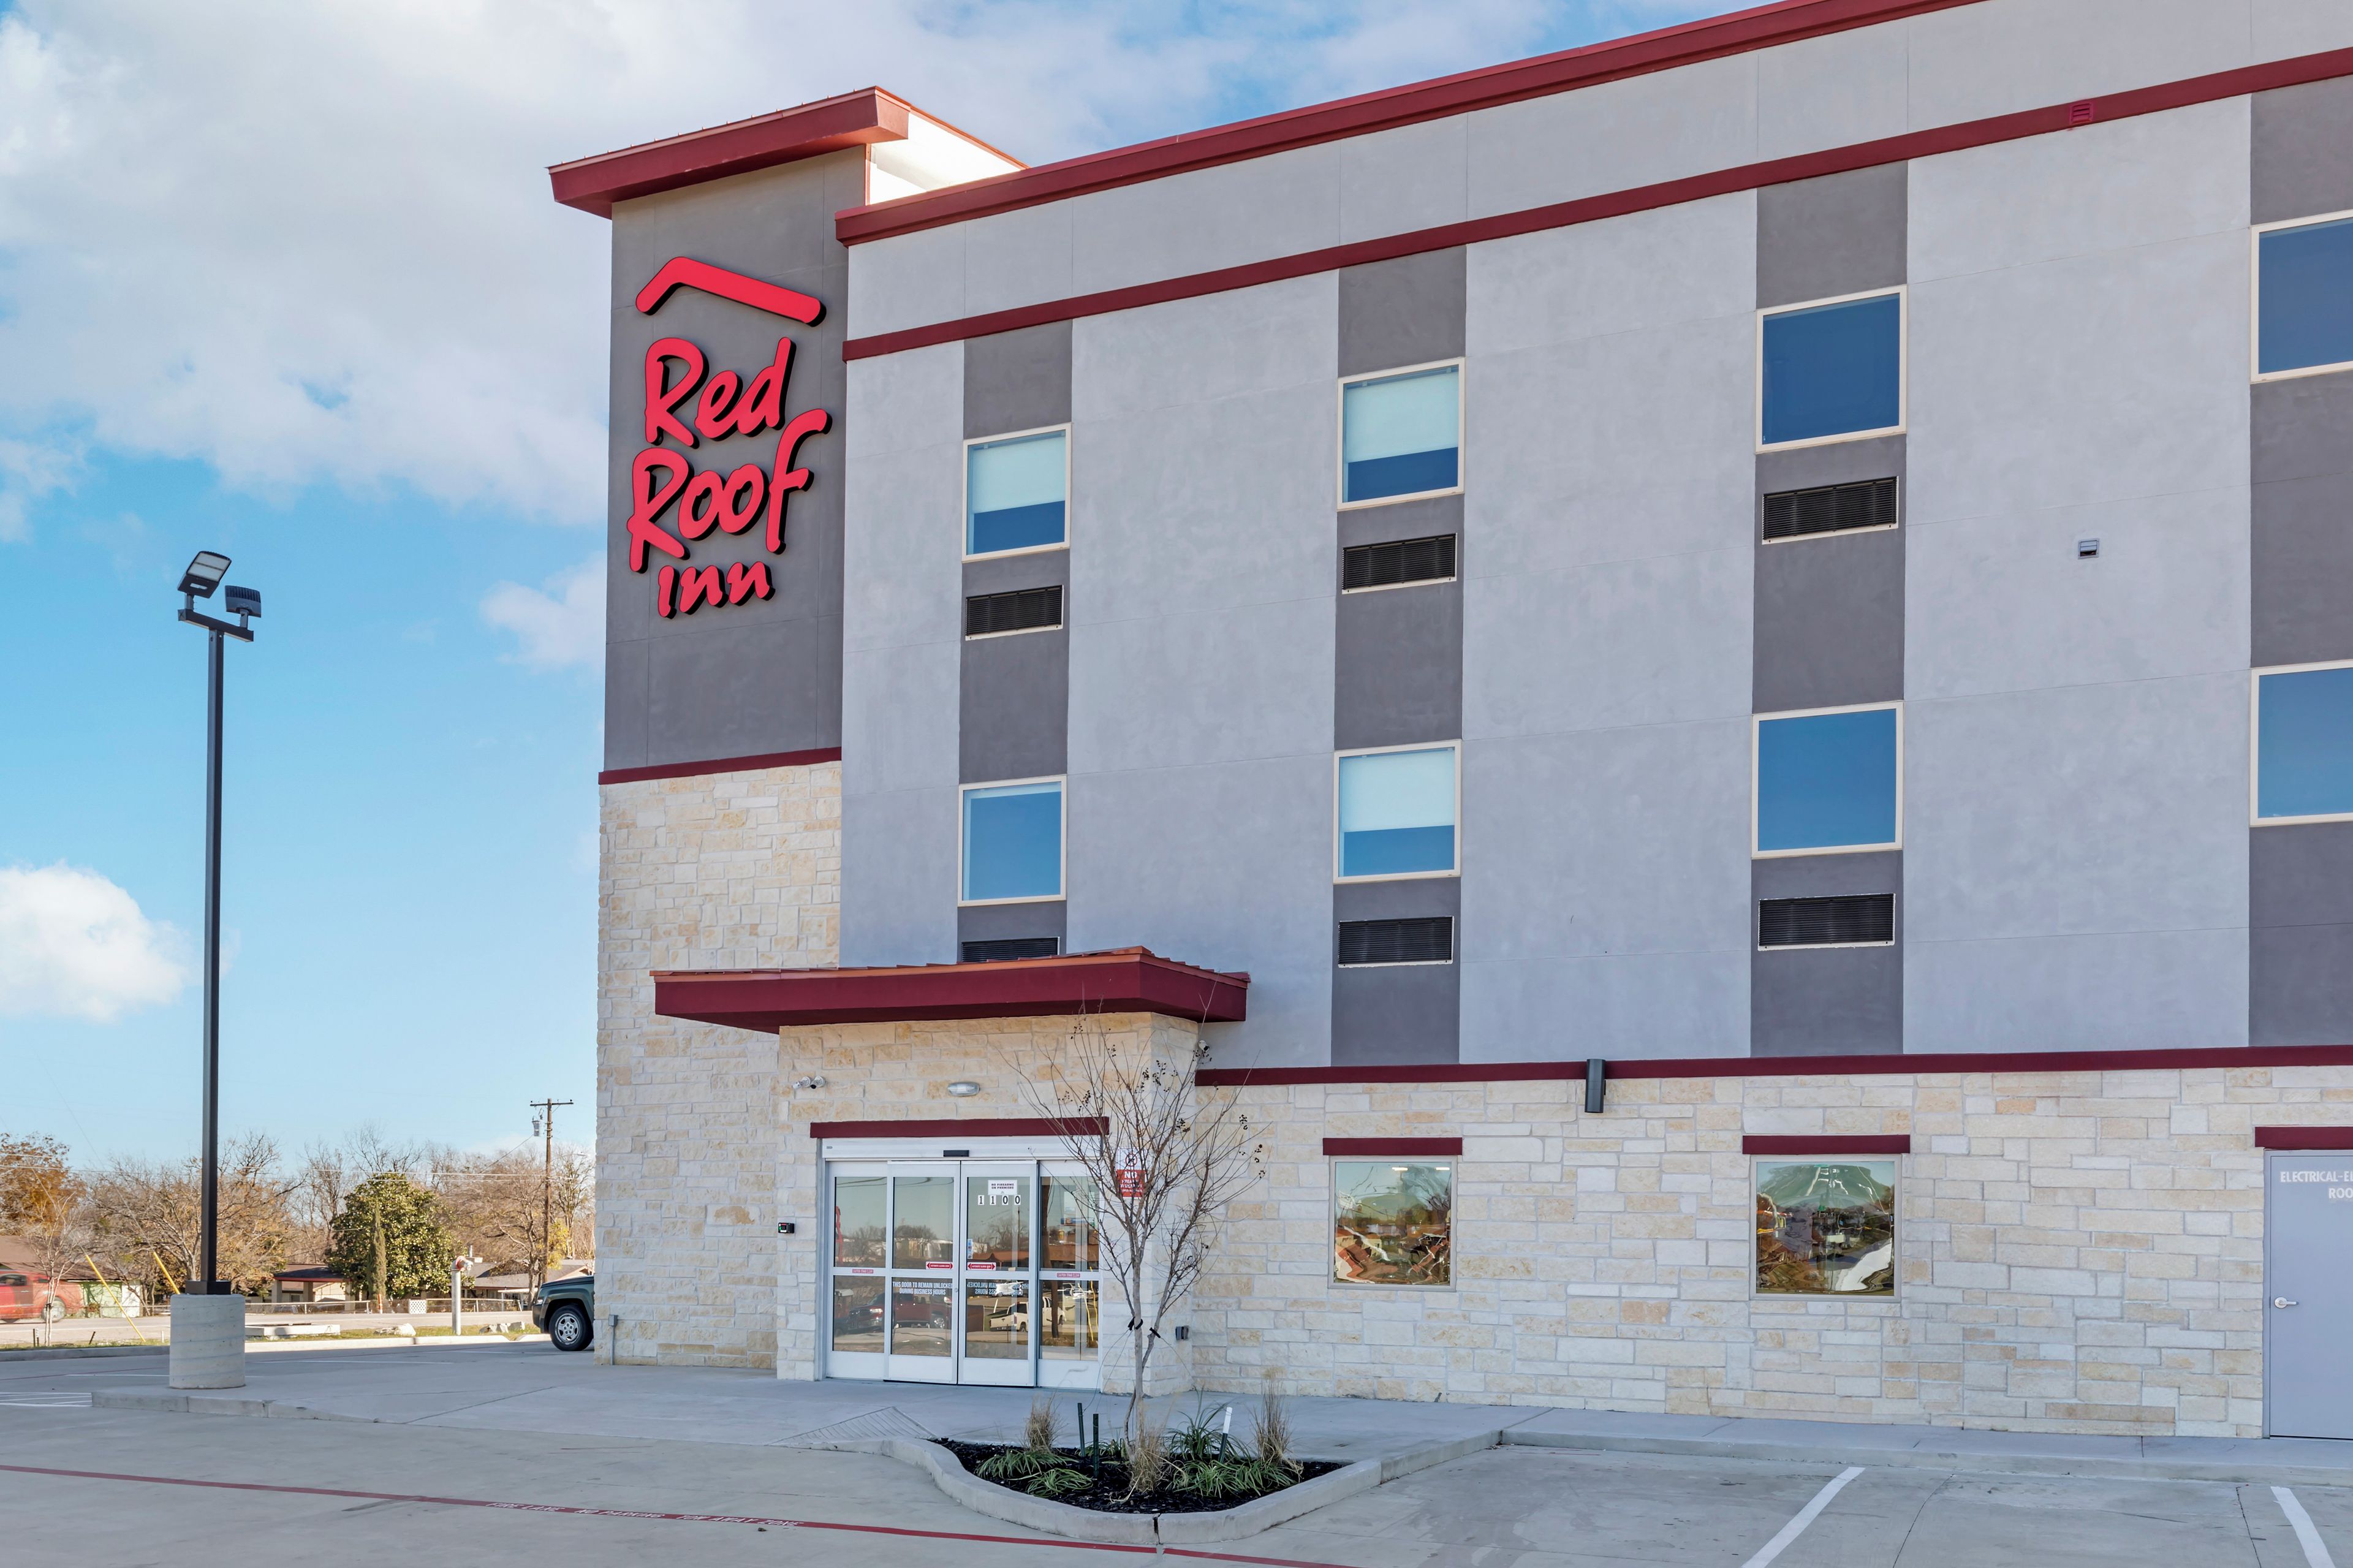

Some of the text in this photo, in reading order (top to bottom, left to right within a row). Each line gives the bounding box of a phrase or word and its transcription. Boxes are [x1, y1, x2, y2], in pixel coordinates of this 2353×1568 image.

[645, 337, 795, 446] Red
[627, 409, 832, 574] Roof
[979, 1195, 1020, 1205] 1100
